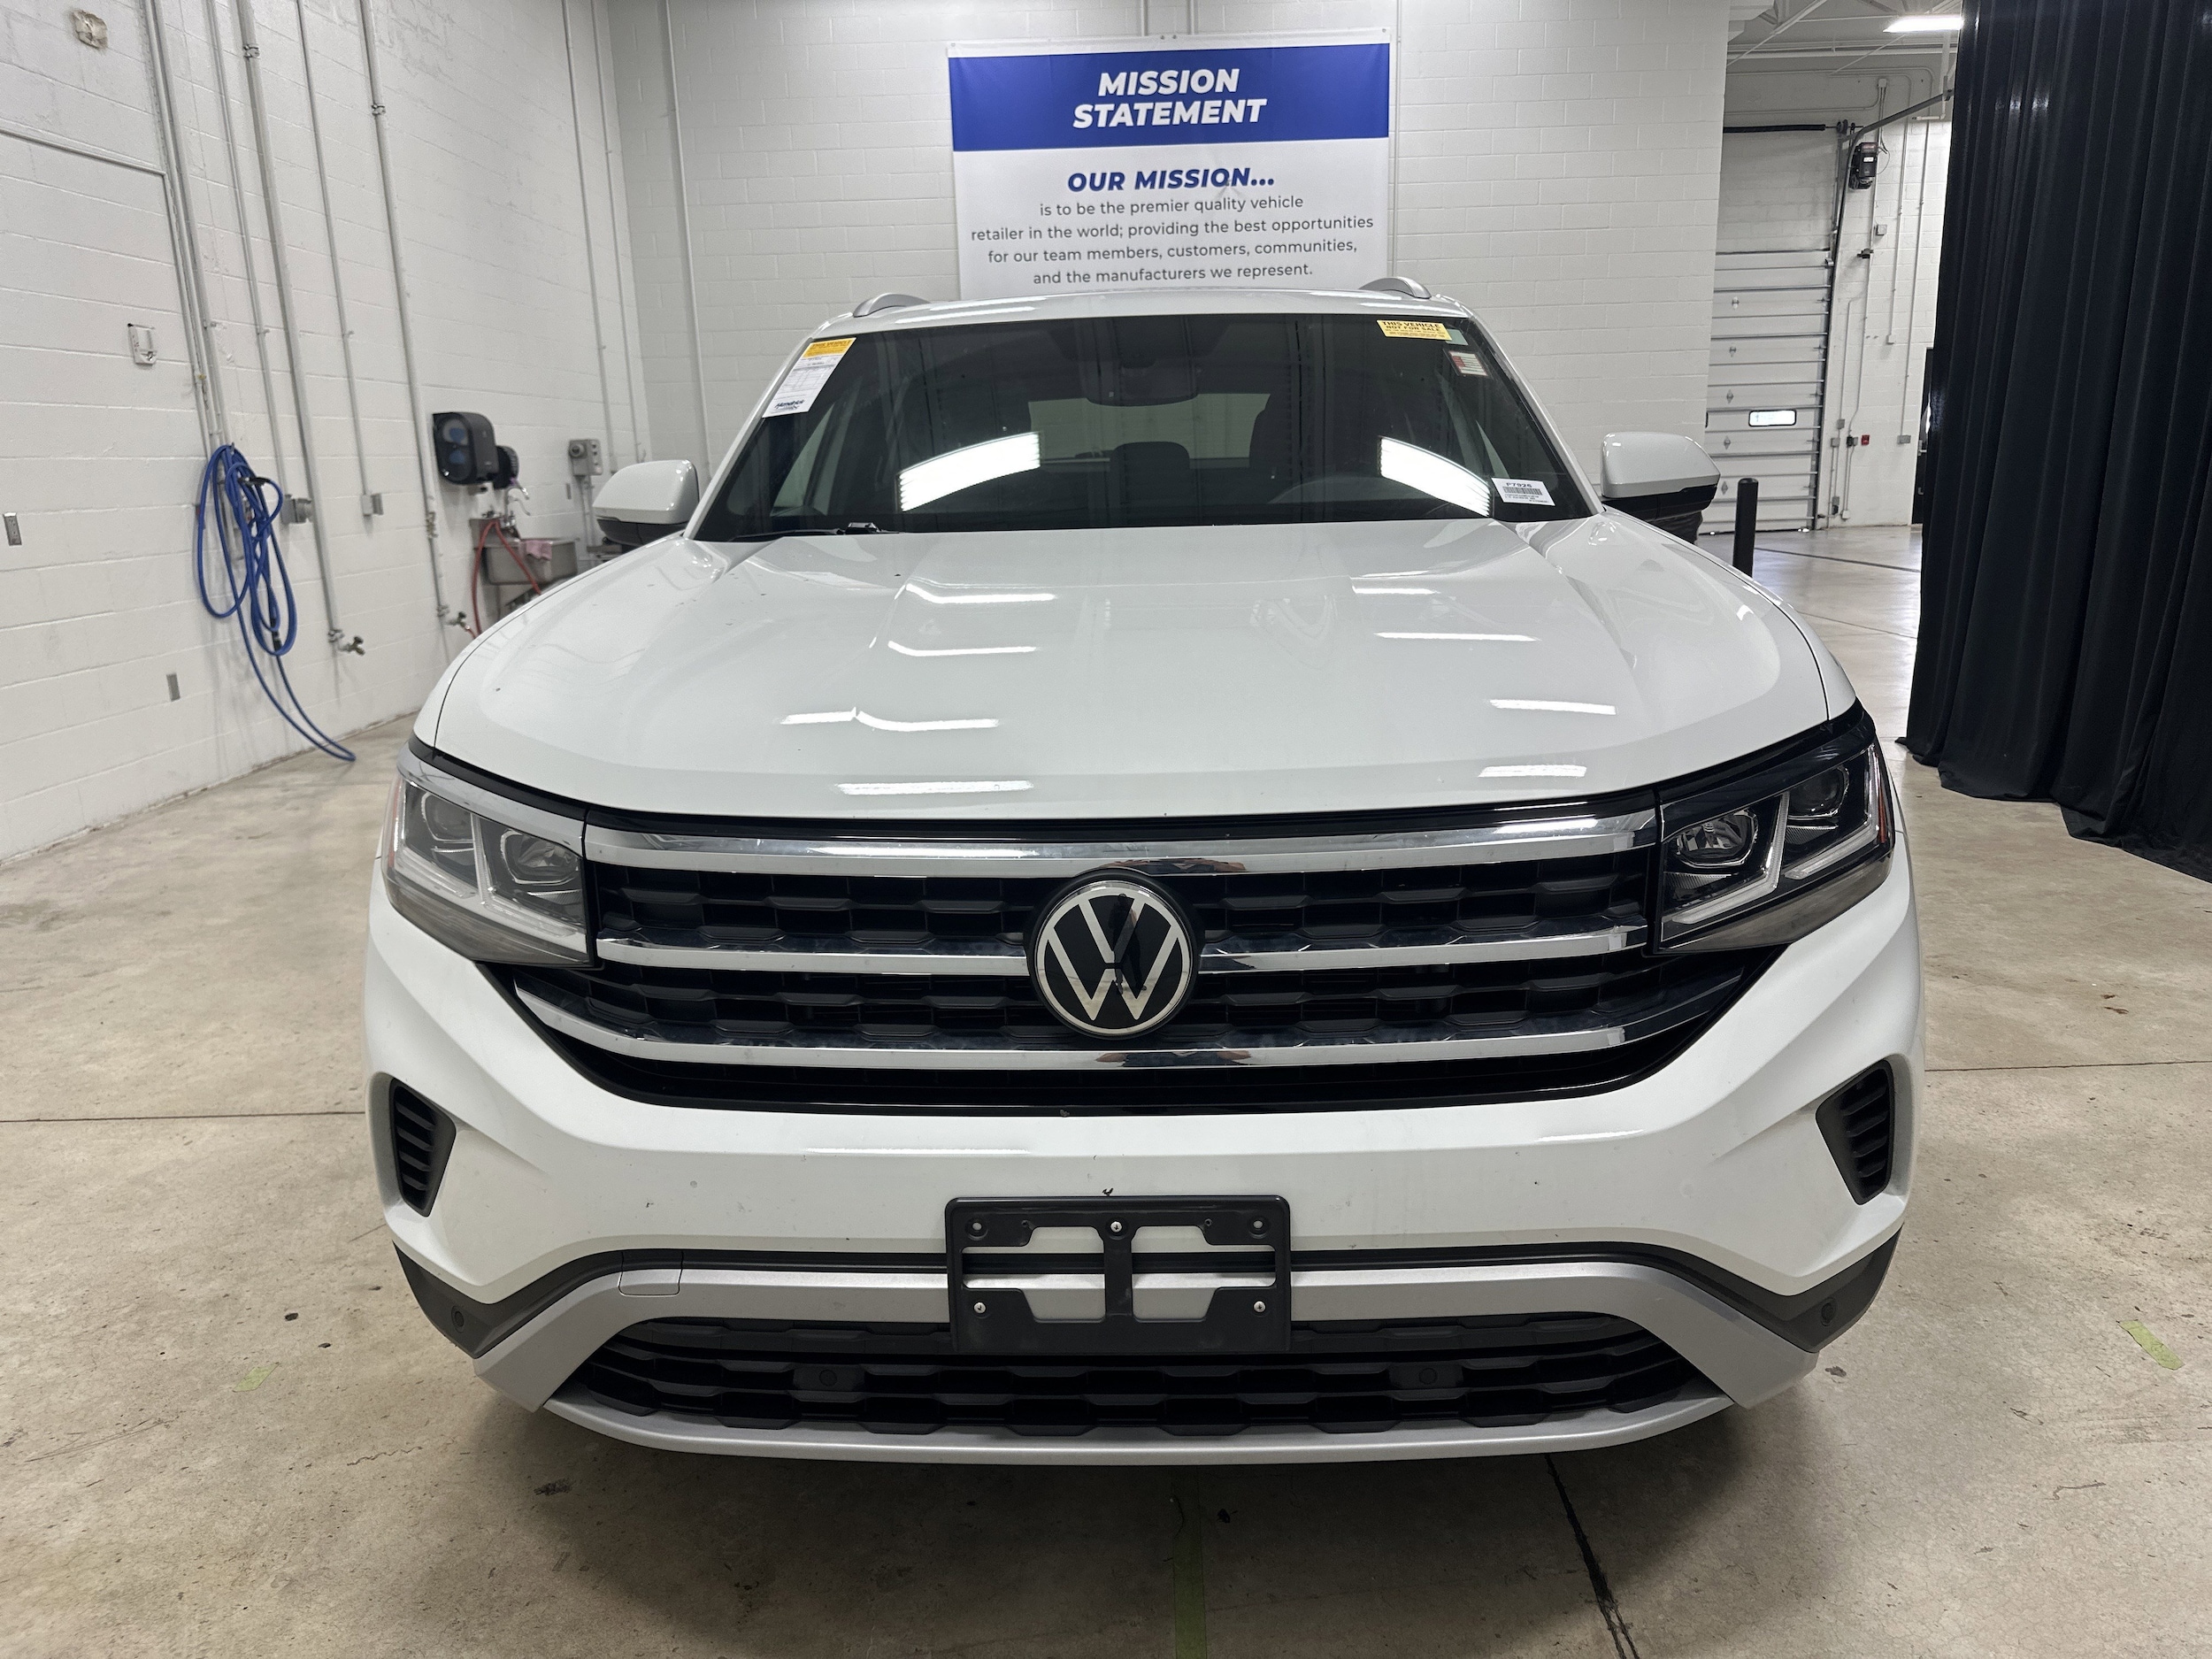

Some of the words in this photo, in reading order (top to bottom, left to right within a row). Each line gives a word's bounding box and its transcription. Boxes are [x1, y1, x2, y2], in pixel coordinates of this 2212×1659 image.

[1097, 68, 1240, 96] MISSION
[1072, 98, 1268, 129] STATEMENT
[1067, 171, 1126, 192] OUR
[1134, 166, 1275, 190] MISSION...
[1040, 203, 1052, 217] is
[1056, 204, 1072, 216] to
[1076, 202, 1096, 215] be
[1099, 201, 1125, 215] the
[1130, 198, 1190, 217] premier
[1194, 196, 1247, 214] quality
[1249, 195, 1304, 211] vehicle
[971, 227, 1025, 242] retailer
[1028, 226, 1042, 240] in
[1047, 226, 1072, 239] the
[1076, 223, 1124, 239] world;
[1127, 221, 1199, 241] providing
[1203, 220, 1229, 234] the
[1233, 219, 1267, 233] best
[1271, 215, 1374, 234] opportunities
[987, 250, 1010, 264] for
[1013, 252, 1039, 263] our
[1042, 250, 1082, 262] team
[1087, 246, 1163, 261] members,
[1166, 242, 1250, 257] customers,
[1254, 238, 1357, 255] communities,
[1033, 271, 1062, 285] and
[1065, 270, 1091, 283] the
[1095, 267, 1206, 283] manufacturers
[1210, 268, 1233, 279] we
[1237, 264, 1313, 281] represent.
